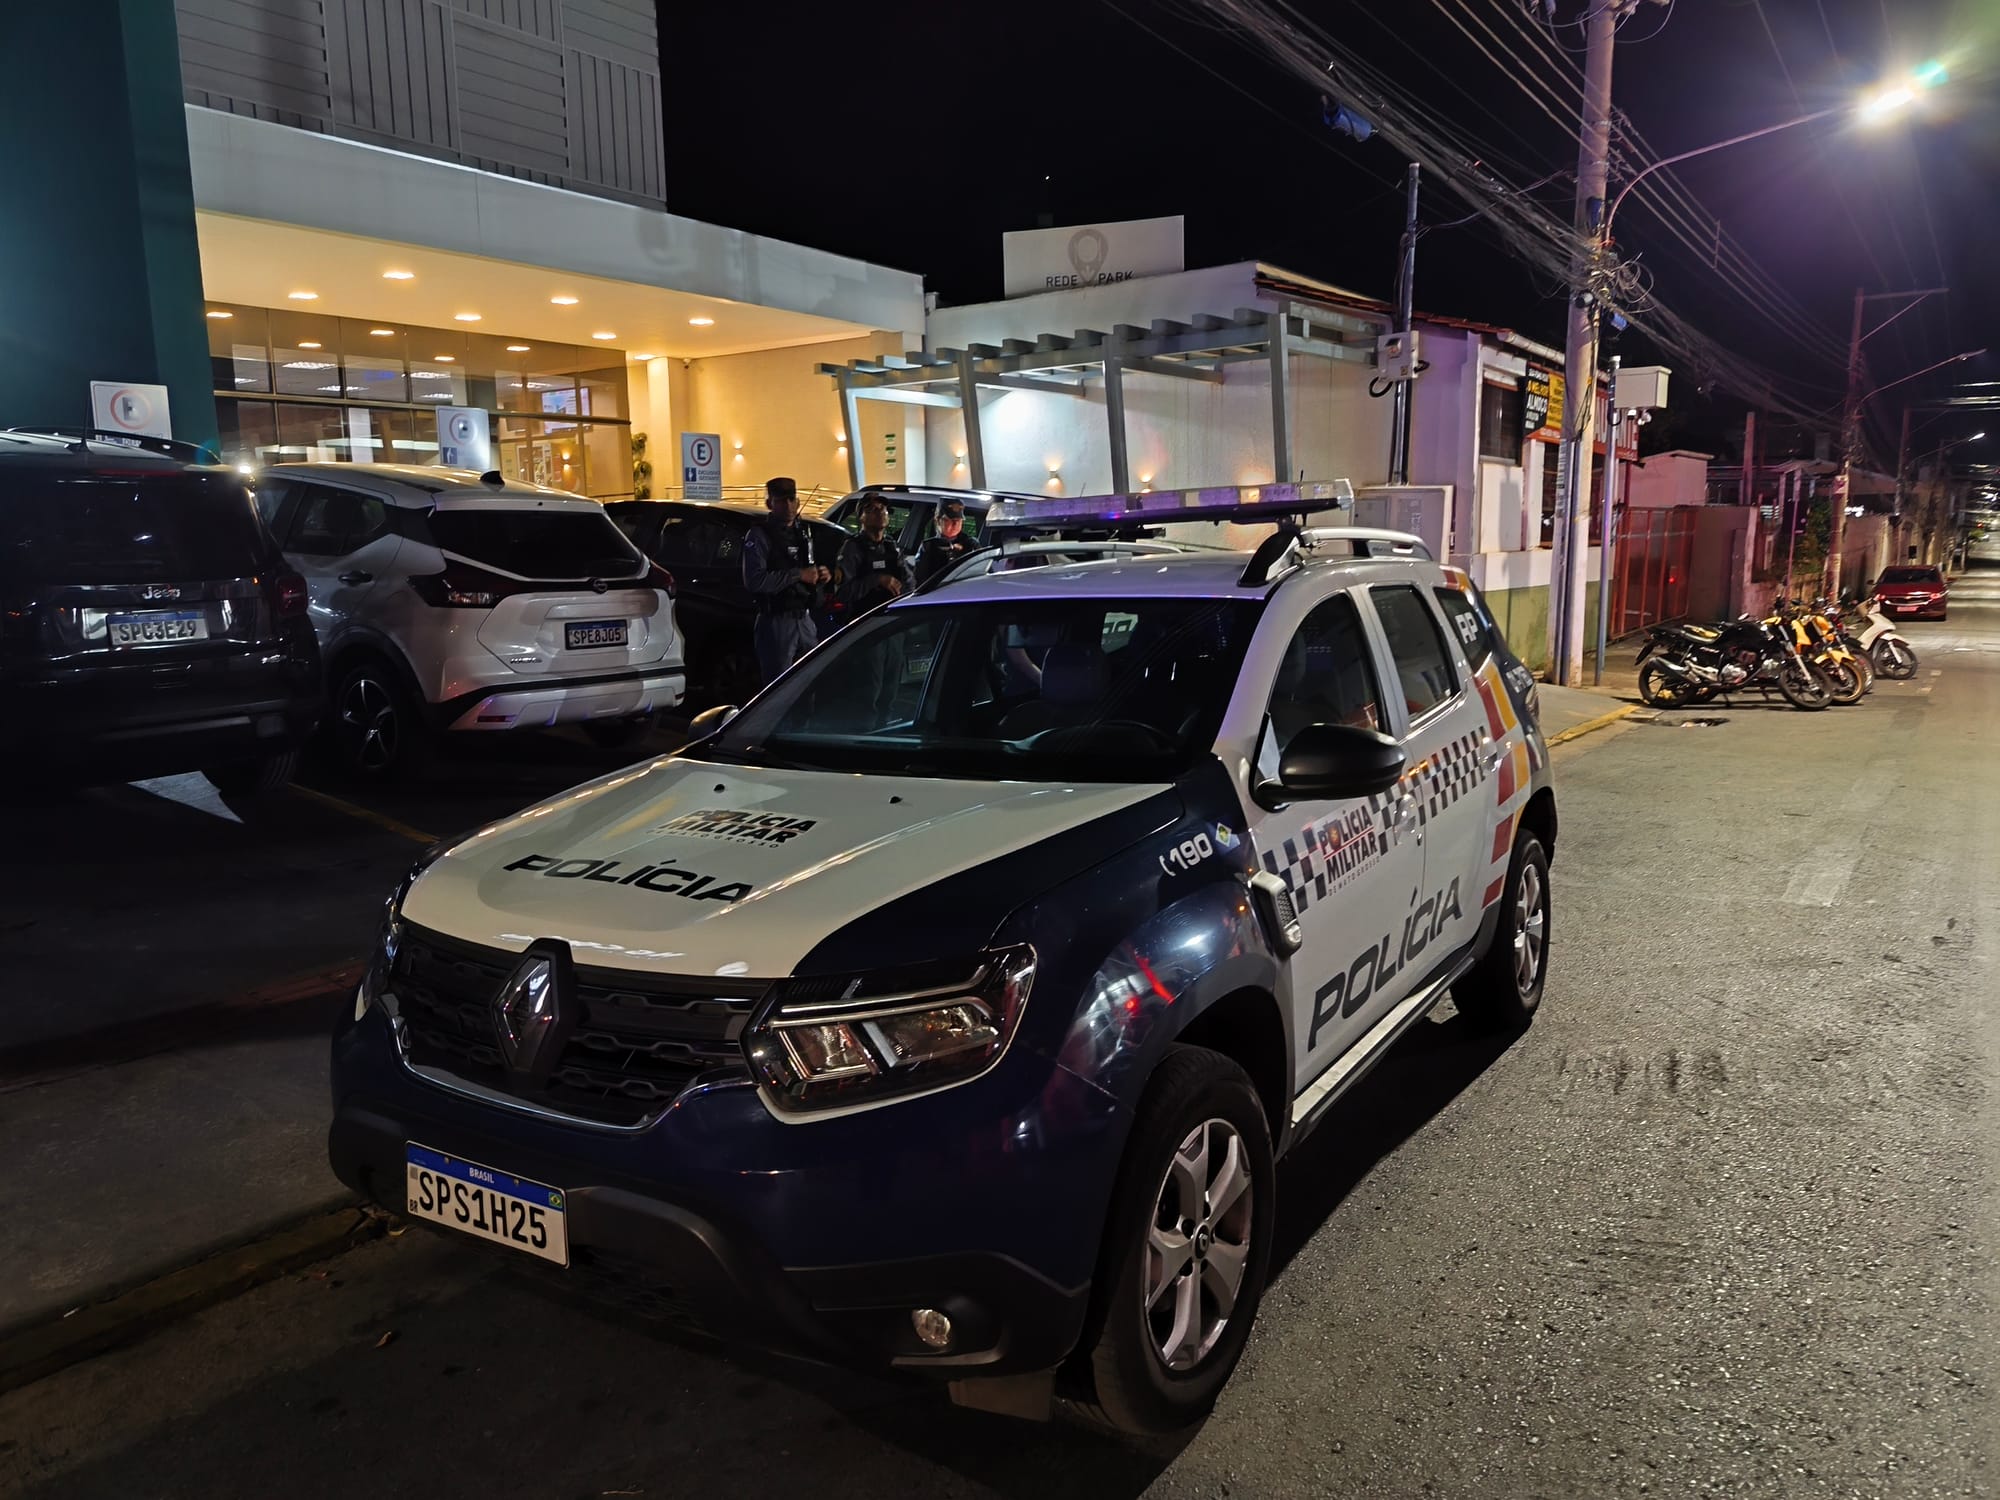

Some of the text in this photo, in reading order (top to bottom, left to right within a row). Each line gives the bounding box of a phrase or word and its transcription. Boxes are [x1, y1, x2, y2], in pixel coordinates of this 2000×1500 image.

[1046, 270, 1134, 288] REDE PARK
[697, 443, 706, 460] E
[573, 627, 621, 644] SPE8J05
[1455, 611, 1479, 644] RP
[657, 819, 798, 843] MILITAR
[688, 809, 817, 833] POLÍCIA
[1317, 805, 1373, 855] POLÍCIA
[1169, 832, 1213, 869] 190
[1326, 831, 1378, 884] MILITAR
[502, 854, 754, 905] POLÍCIA
[1307, 875, 1463, 1053] POLÍCIA
[469, 1167, 495, 1184] BRASIL
[409, 1199, 419, 1214] BR
[419, 1171, 547, 1249] SPS1H25
